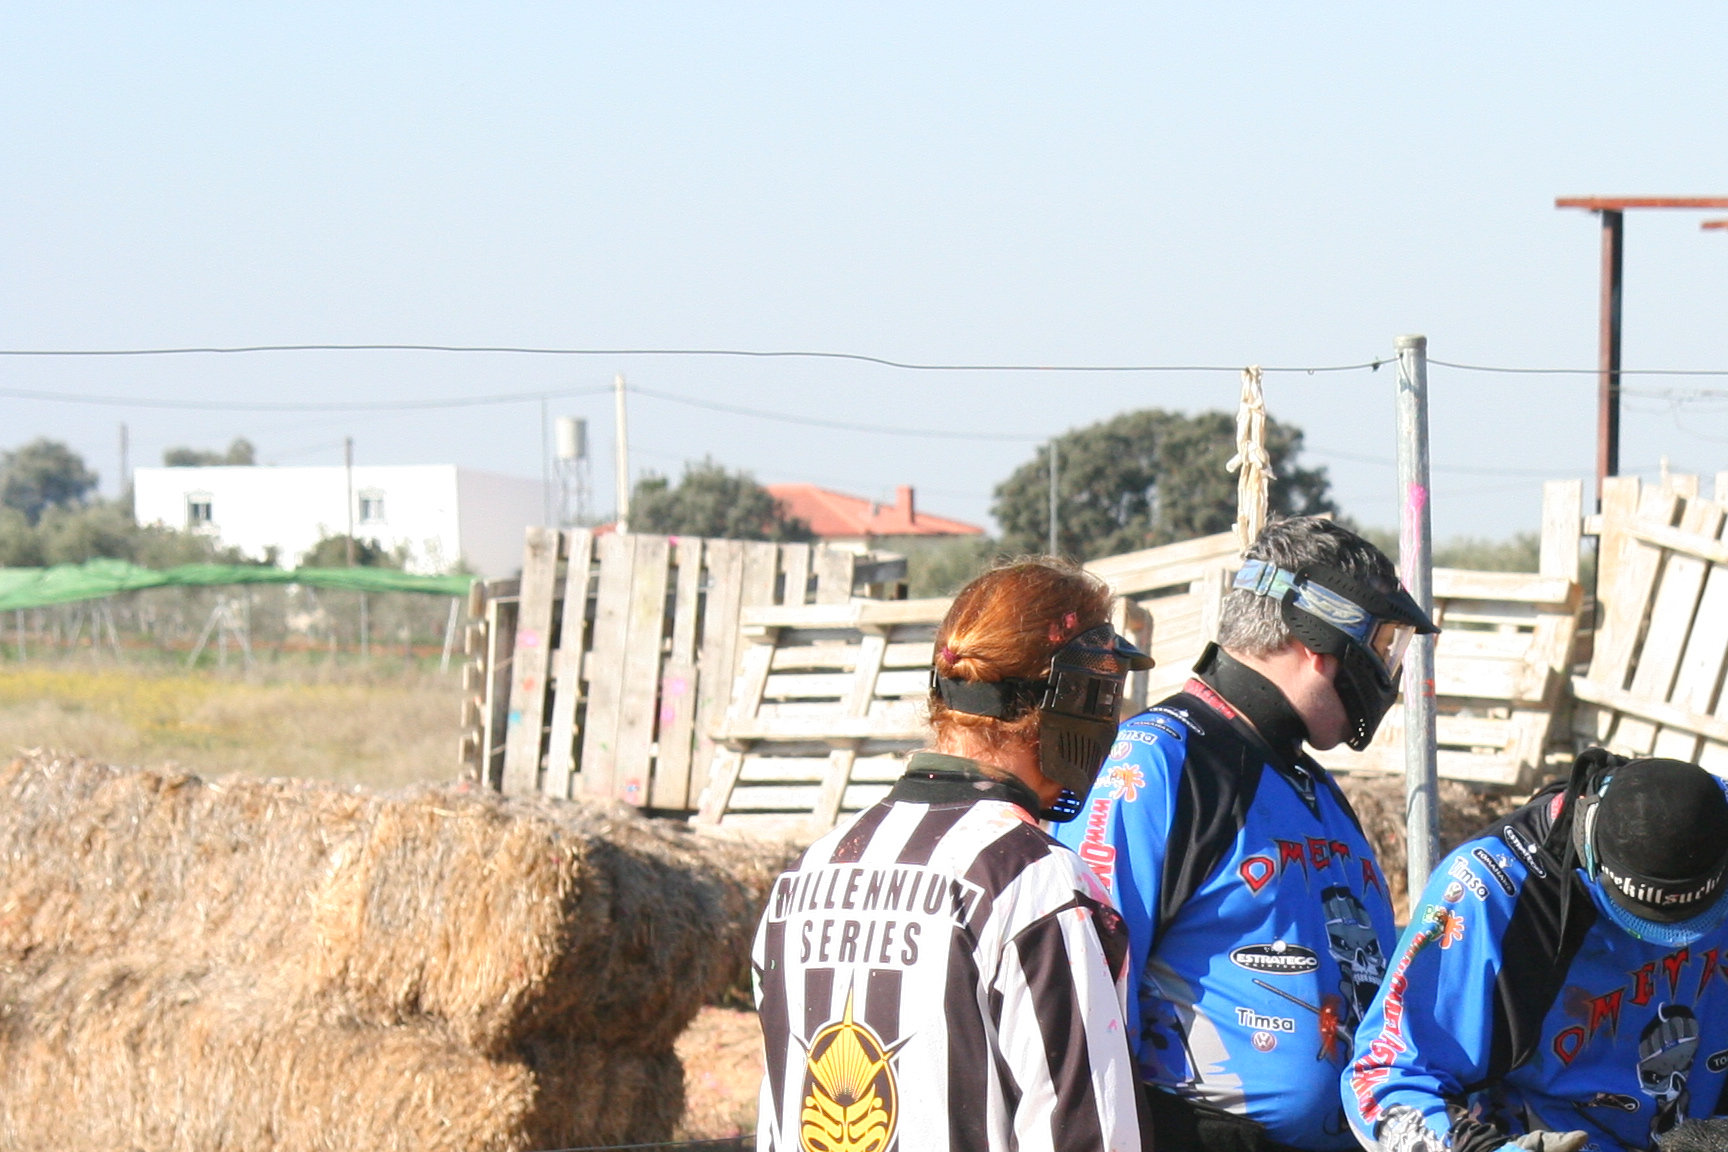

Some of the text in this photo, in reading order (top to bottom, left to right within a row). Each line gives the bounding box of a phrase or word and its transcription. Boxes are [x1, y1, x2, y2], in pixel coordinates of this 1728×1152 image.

[773, 868, 980, 919] MILLENNIUM
[801, 920, 921, 965] SERIES
[1236, 953, 1318, 966] ESTRATEGO
[1236, 1008, 1294, 1032] Timsa
